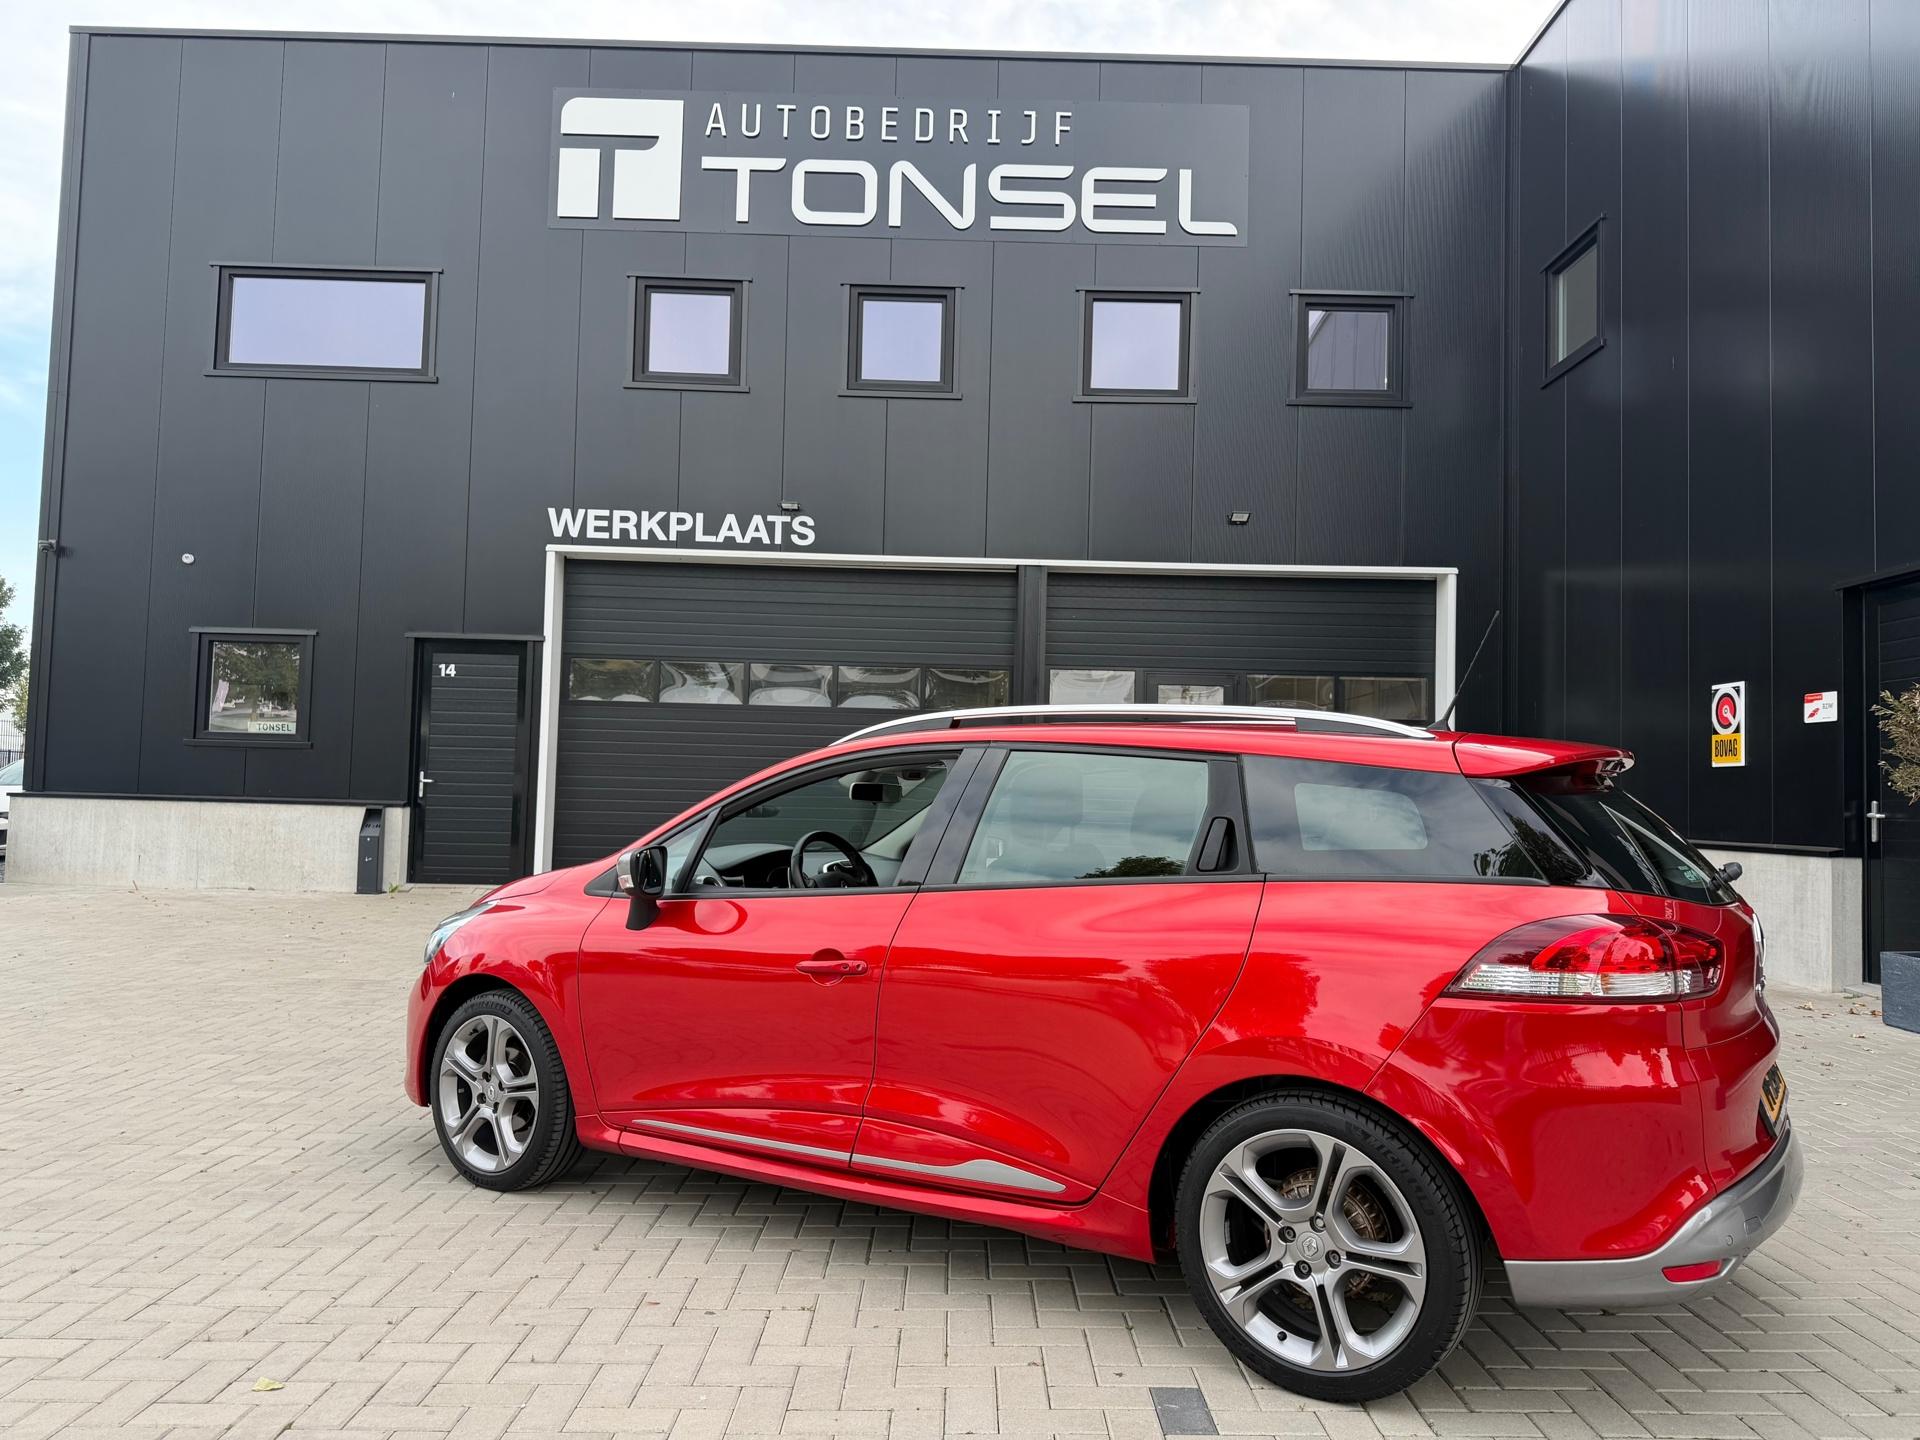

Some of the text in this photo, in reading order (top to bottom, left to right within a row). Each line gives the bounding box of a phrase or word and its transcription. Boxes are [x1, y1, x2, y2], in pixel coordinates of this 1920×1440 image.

[704, 101, 1073, 145] AUTOBEDRIJF
[701, 155, 1238, 236] TONSEL
[547, 507, 816, 546] WERKPLAATS
[438, 663, 457, 678] 14
[257, 723, 292, 732] TONSEL
[1714, 738, 1738, 758] BOVAG
